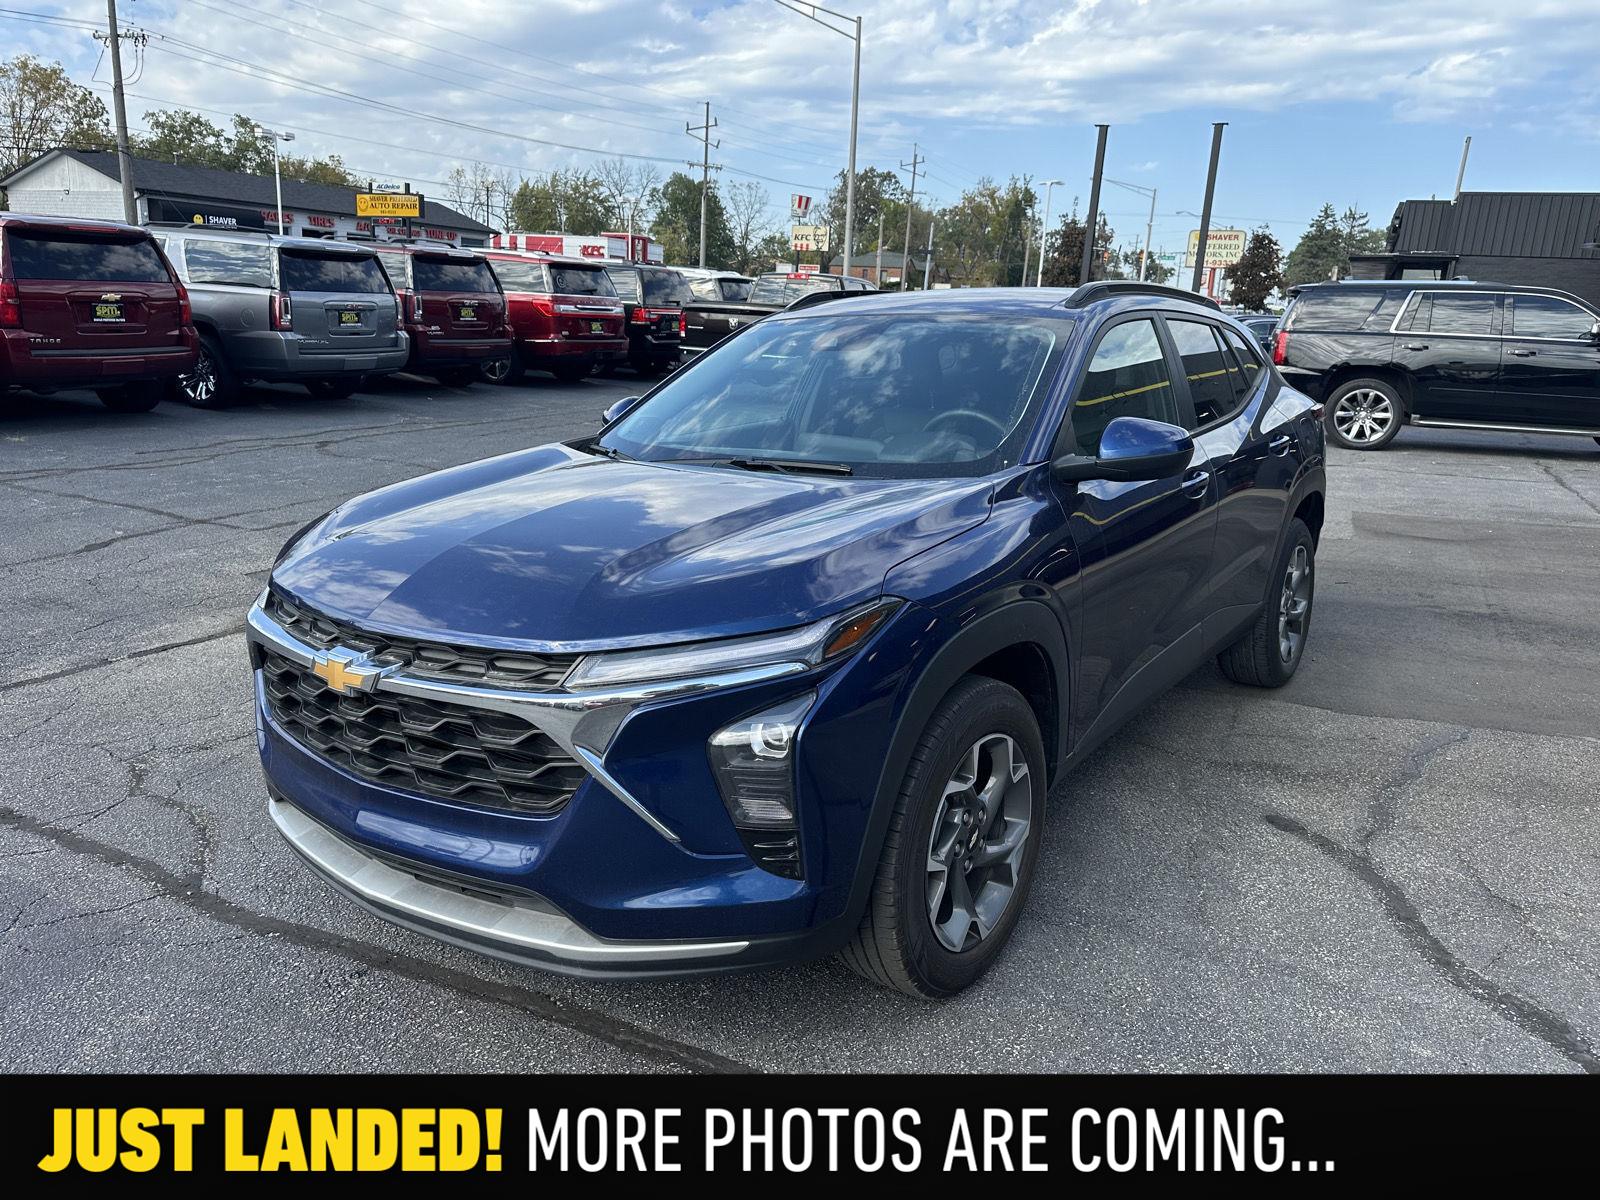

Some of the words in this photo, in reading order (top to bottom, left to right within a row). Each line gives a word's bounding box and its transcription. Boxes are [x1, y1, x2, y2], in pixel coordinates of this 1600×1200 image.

[209, 216, 238, 226] SHAVER
[308, 215, 336, 228] TIRES
[793, 233, 811, 241] KFC
[582, 244, 605, 256] KFC
[1188, 251, 1224, 259] MORS,
